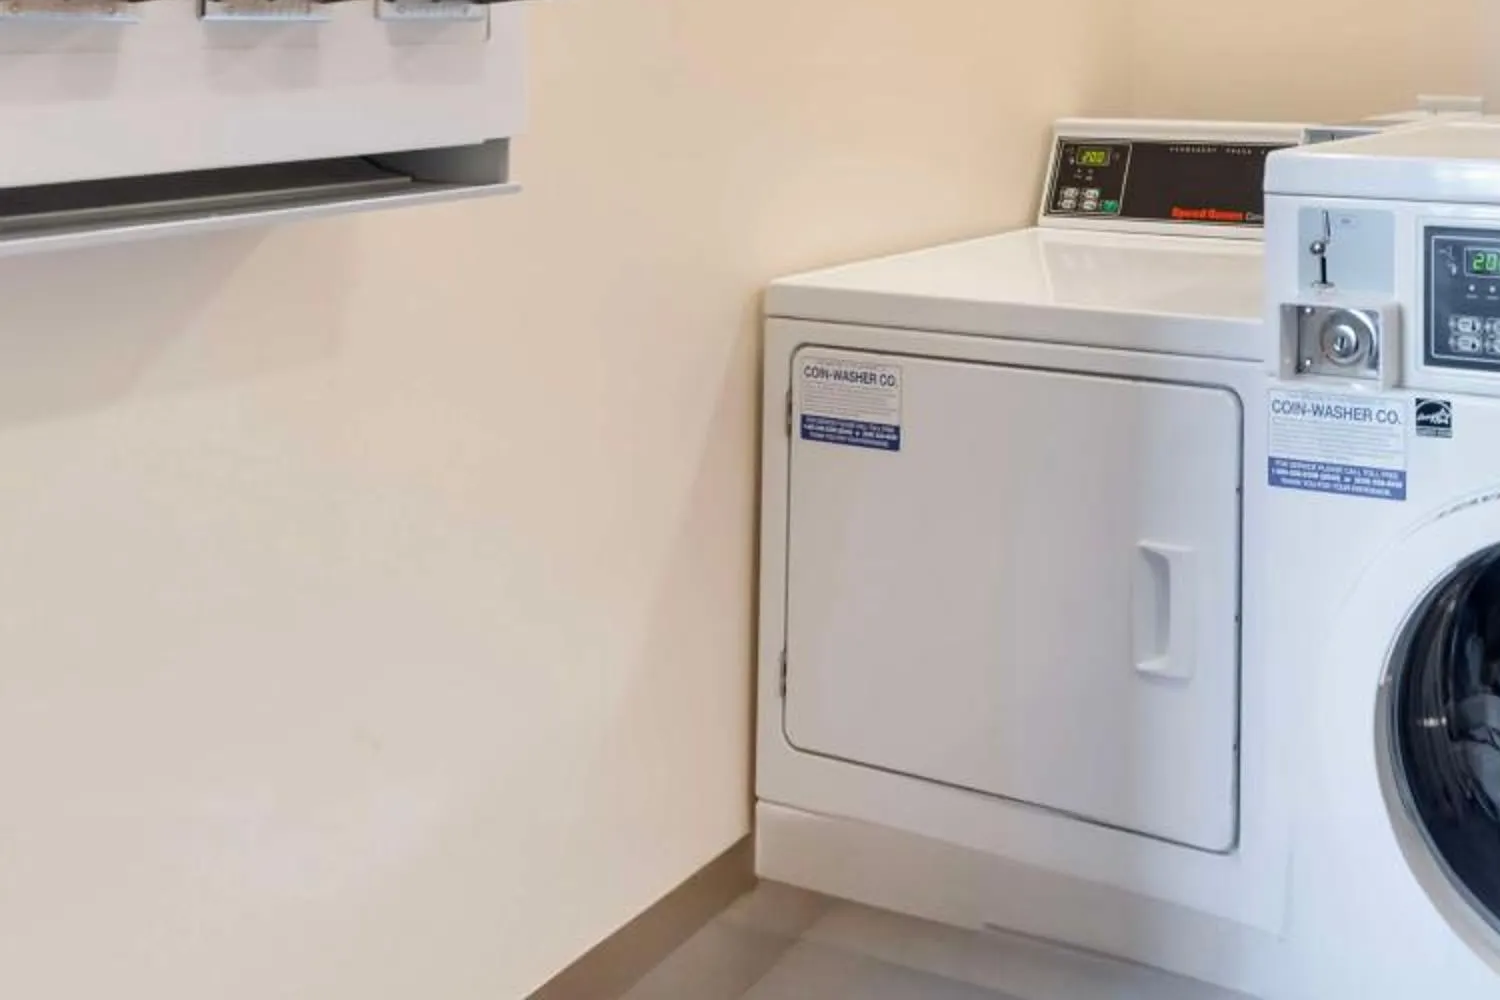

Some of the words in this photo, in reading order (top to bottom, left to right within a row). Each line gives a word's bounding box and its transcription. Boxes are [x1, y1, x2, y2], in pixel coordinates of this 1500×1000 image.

[803, 365, 877, 385] COIN-WASHER
[1271, 399, 1373, 422] COIN-WASHER
[1375, 409, 1402, 425] CO.
